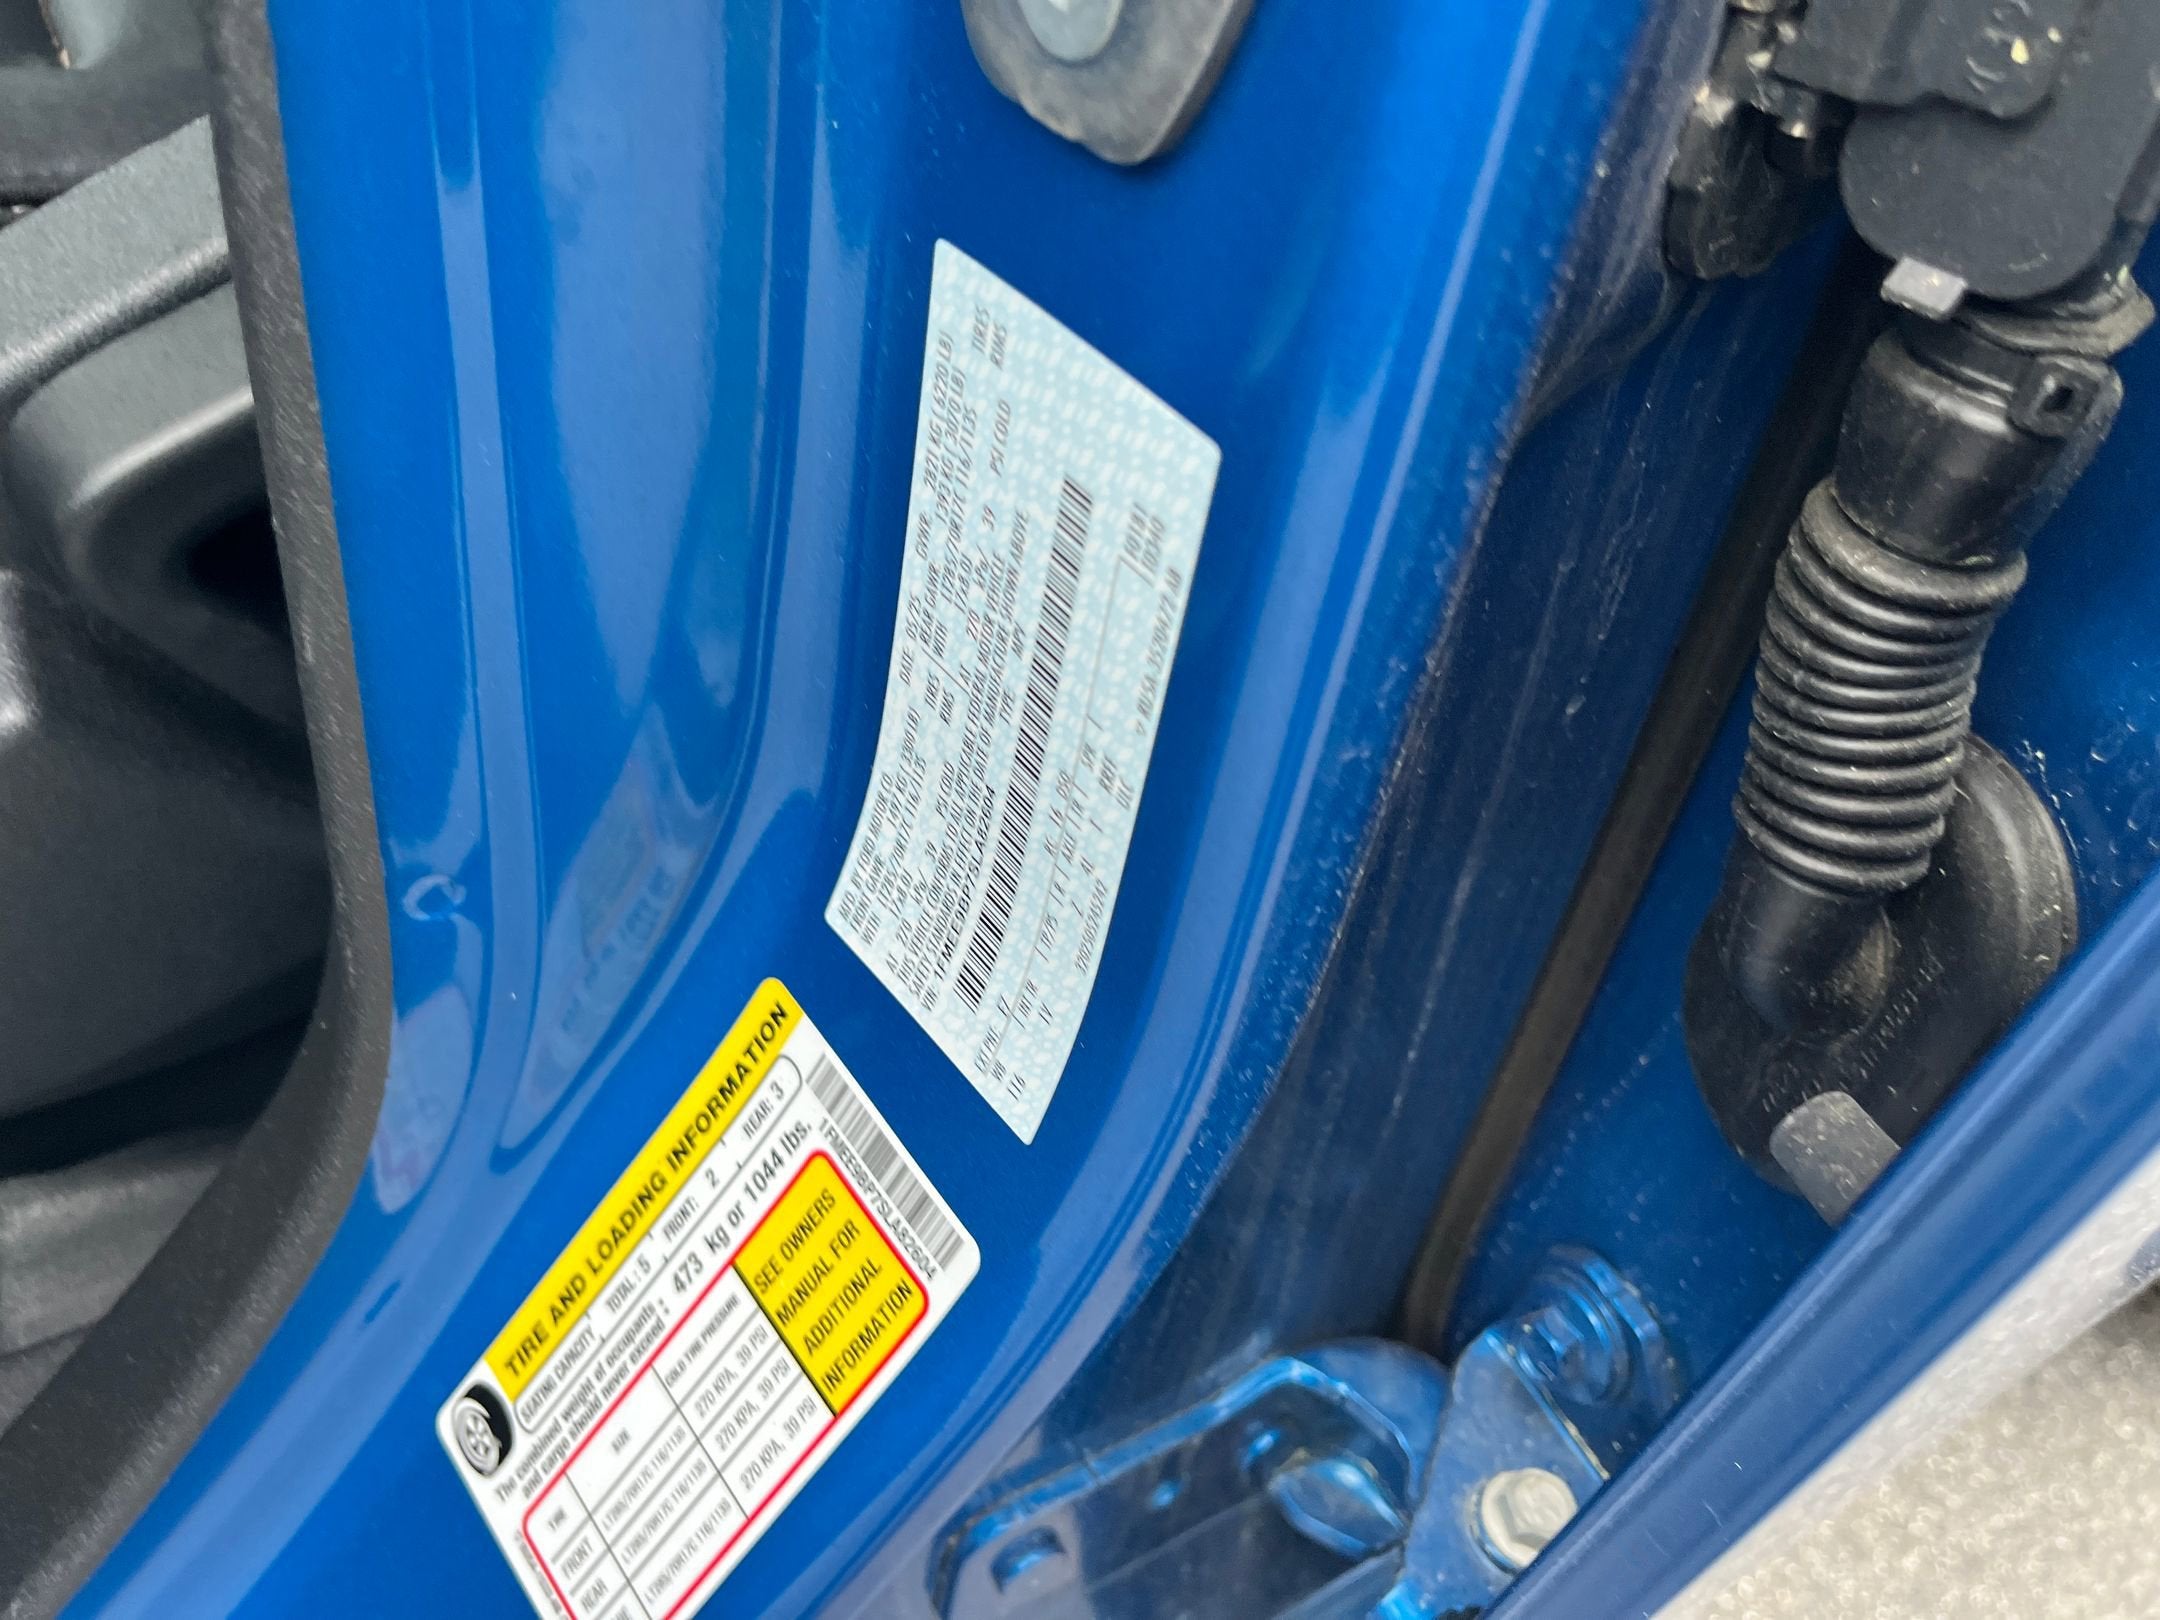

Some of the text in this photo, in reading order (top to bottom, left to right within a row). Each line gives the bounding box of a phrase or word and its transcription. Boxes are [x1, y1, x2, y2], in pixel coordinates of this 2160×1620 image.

[969, 299, 991, 356] TIRES
[988, 318, 1008, 371] RIMS
[926, 418, 943, 449] KG
[992, 395, 1012, 449] COLD
[921, 445, 940, 494] 2821
[939, 453, 954, 485] KG
[988, 442, 1005, 479] PSI
[933, 479, 952, 526] 1393
[980, 502, 997, 533] 39
[997, 560, 1020, 625] SHOWN
[903, 590, 922, 643] 05/25
[917, 606, 935, 648] REAR
[930, 617, 949, 660] WITH
[1009, 619, 1027, 661] MPV
[922, 667, 941, 711] TIRES
[980, 620, 1011, 729] MANUFACTURE
[938, 686, 955, 728] RIMS
[977, 722, 992, 748] OF
[895, 546, 1006, 987] THIS VEHICLE CONFORMS TO ALL APPLICABLE FEDERAL MOTOR VEHICLE
[938, 756, 956, 798] COLD
[971, 741, 989, 783] DATE
[866, 788, 890, 841] MOTOR
[933, 792, 950, 821] PSI
[962, 802, 978, 829] ON
[966, 776, 983, 809] THE
[1046, 802, 1064, 830] 16
[847, 889, 872, 934] FRONT
[893, 770, 908, 797] KG
[855, 833, 877, 873] FORD
[923, 839, 938, 865] 39
[952, 822, 974, 872] EFFECT
[1058, 824, 1078, 867] AXLE
[848, 865, 864, 892] BY
[948, 866, 963, 889] IN
[859, 909, 882, 947] WITH
[924, 881, 959, 958] STANDARDS
[906, 950, 933, 1000] SAFETY
[1005, 1071, 1026, 1102] 116
[741, 1097, 774, 1140] REAR:
[503, 1000, 789, 1377] TIRE AND LOADING INFORMATION
[671, 1120, 812, 1294] 473 kg or 1044 lbs.
[752, 1187, 836, 1295] SEE OWNERS
[774, 1217, 861, 1328] MANUAL FOR
[801, 1256, 883, 1357] ADDITIONAL
[820, 1277, 913, 1395] INFORMATION
[514, 1323, 602, 1424] SEATING CAPACITY
[693, 1387, 716, 1419] 270
[747, 1323, 769, 1351] PSI
[493, 1301, 659, 1503] The combined weight of occupants
[520, 1465, 544, 1500] and
[539, 1435, 571, 1476] cargo
[567, 1392, 603, 1441] should
[599, 1359, 630, 1401] never
[627, 1312, 666, 1366] exceed
[713, 1420, 738, 1452] 270
[768, 1355, 791, 1384] PSI
[738, 1459, 763, 1492] 270
[794, 1394, 818, 1423] PSI
[559, 1535, 593, 1580] FRONT
